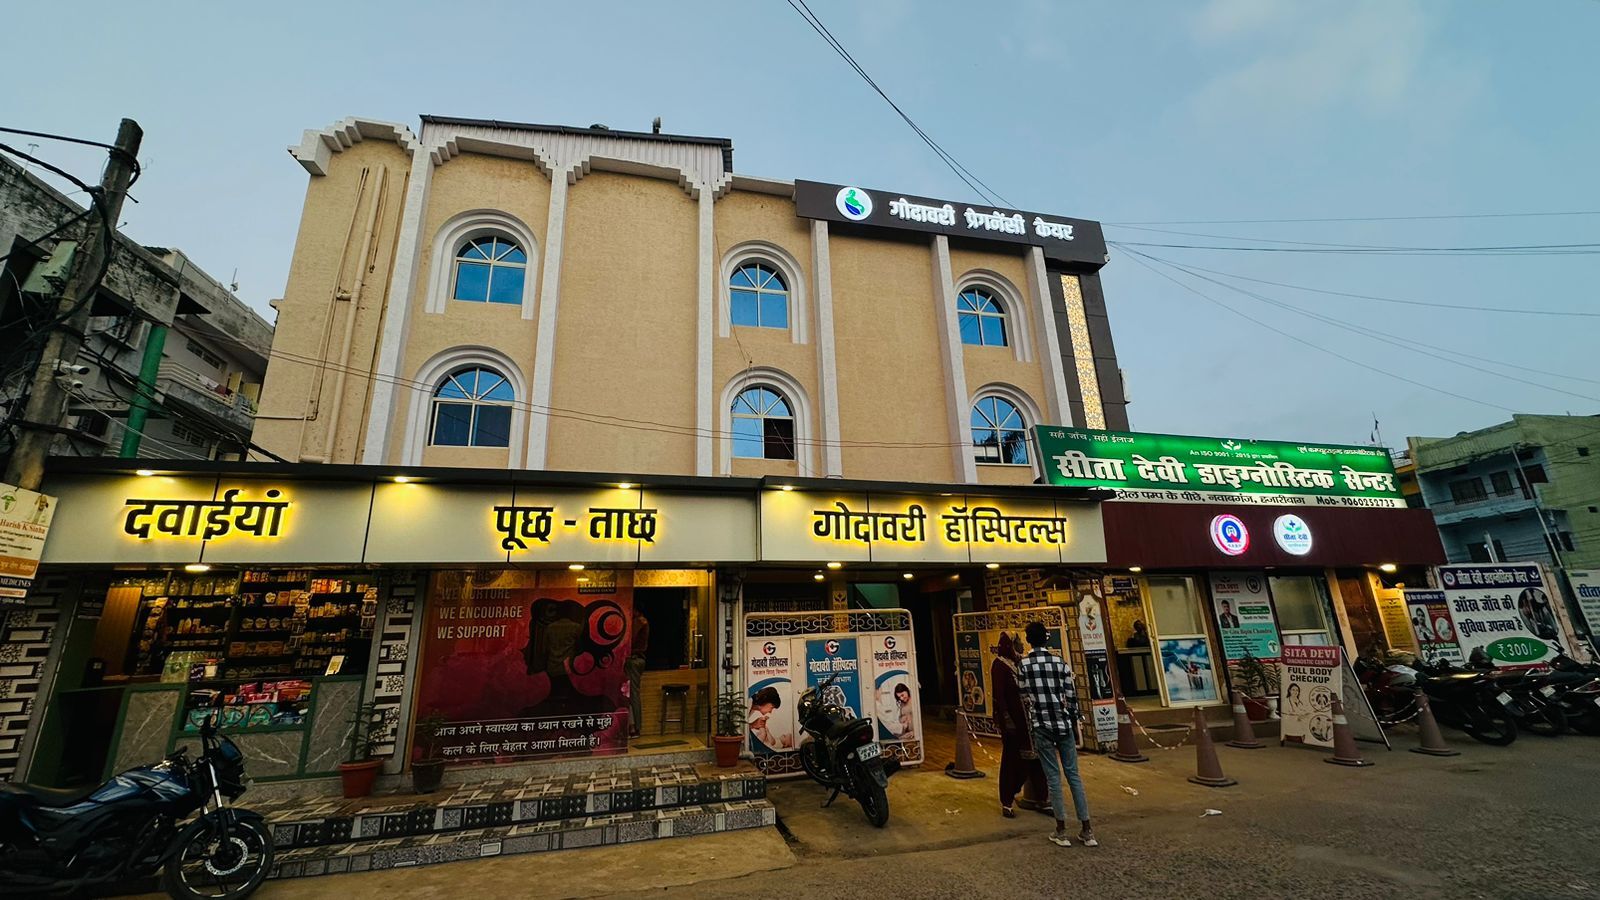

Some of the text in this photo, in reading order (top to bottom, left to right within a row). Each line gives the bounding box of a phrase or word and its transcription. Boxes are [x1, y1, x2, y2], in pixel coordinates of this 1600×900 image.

[889, 198, 956, 227] गोदावरी
[1033, 216, 1075, 240] केयर
[1049, 431, 1066, 440] सही
[1052, 450, 1127, 480] सीता
[1132, 454, 1188, 484] देवी
[1339, 465, 1397, 492] सेन्टर
[1115, 490, 1139, 500] ट्रोल
[1141, 492, 1163, 501] पम्प
[1166, 491, 1178, 501] के
[124, 489, 291, 540] दवाईयां
[813, 501, 1067, 544] गोदावरी हॉस्पिटल्स
[493, 506, 554, 549] पूछ
[589, 507, 658, 543] ताछ
[439, 606, 523, 619] WE ENCOURAGE
[437, 624, 508, 639] WE SUPPORT
[1284, 648, 1337, 659] SITA DEVI
[1288, 666, 1333, 676] FULL BODY
[1290, 674, 1330, 684] CHECKUP
[459, 722, 482, 735] अपने
[521, 720, 535, 732] का
[538, 720, 560, 731] ध्यान
[562, 716, 583, 730] रखने
[586, 715, 595, 727] से
[596, 714, 613, 731] मुझे
[443, 746, 462, 756] कल
[466, 742, 475, 754] के
[479, 741, 499, 755] लिए
[502, 739, 528, 752] बेहतर
[531, 738, 555, 751] आशा
[558, 735, 586, 749] मिलती
